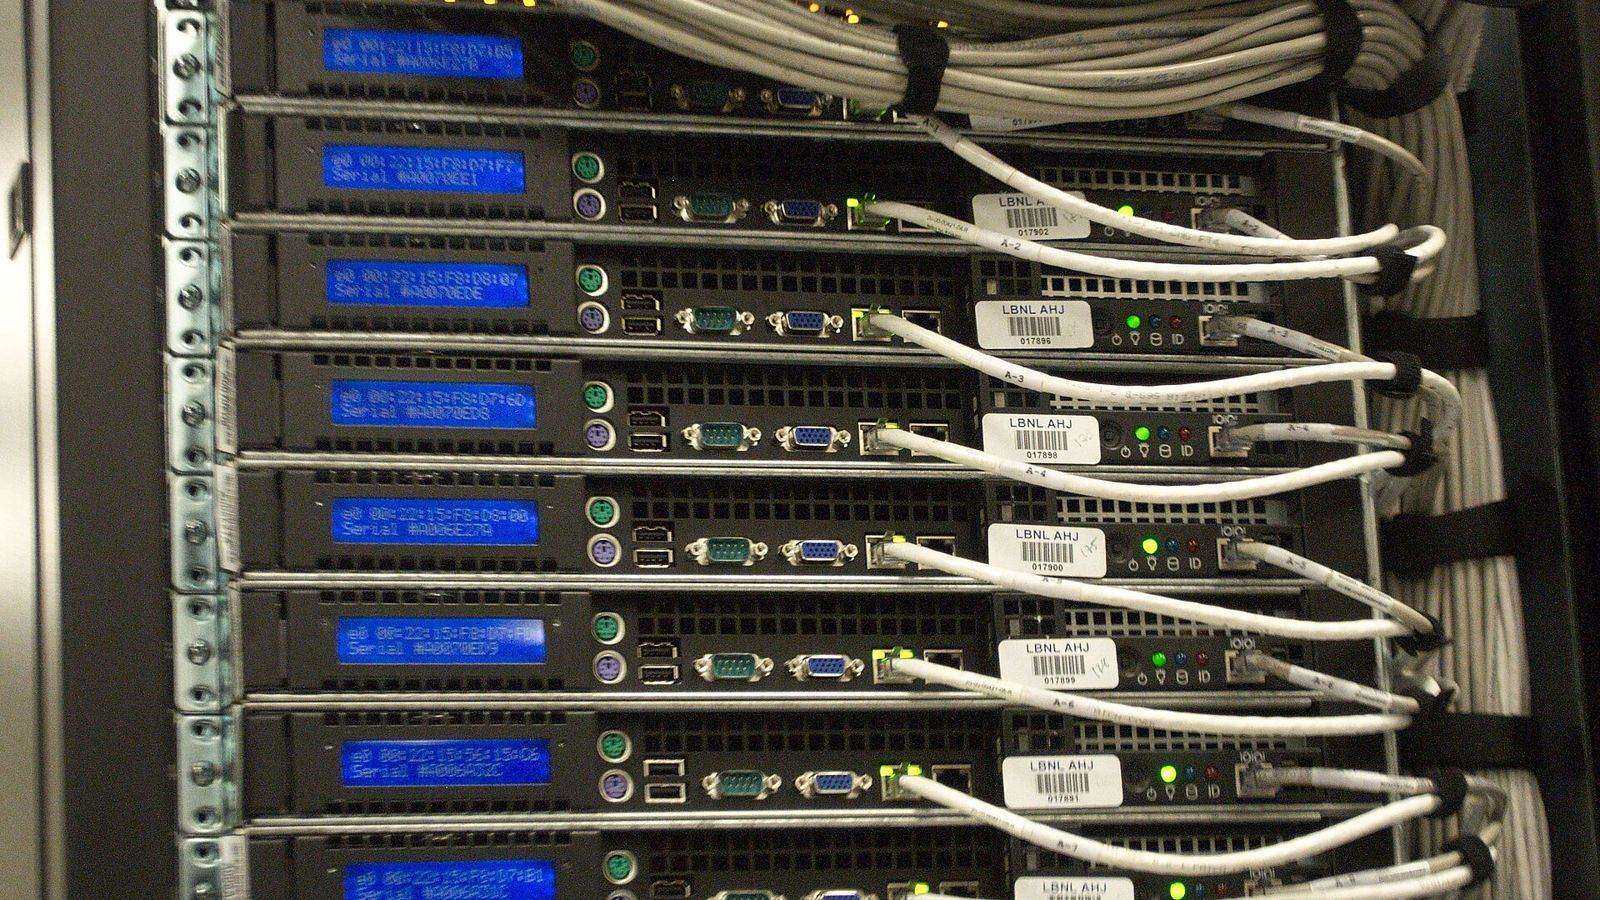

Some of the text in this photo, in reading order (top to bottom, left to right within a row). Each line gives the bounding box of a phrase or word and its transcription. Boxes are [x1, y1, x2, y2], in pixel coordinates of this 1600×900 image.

[332, 166, 388, 183] Serial
[999, 196, 1032, 207] LBNL
[1001, 238, 1022, 251] A-2
[334, 282, 390, 298] Serial
[1003, 304, 1066, 316] LBNL AHJ
[1005, 370, 1025, 383] A-3
[340, 402, 397, 418] Serial
[1010, 417, 1072, 430] LBNL AHJ
[341, 521, 398, 536] Serial
[1015, 528, 1080, 542] LBNL AHJ
[1032, 563, 1064, 572] 017900
[348, 639, 405, 656] Serial
[1026, 642, 1090, 654] LBNL AHJ
[1030, 760, 1095, 772] LBNL AHJ
